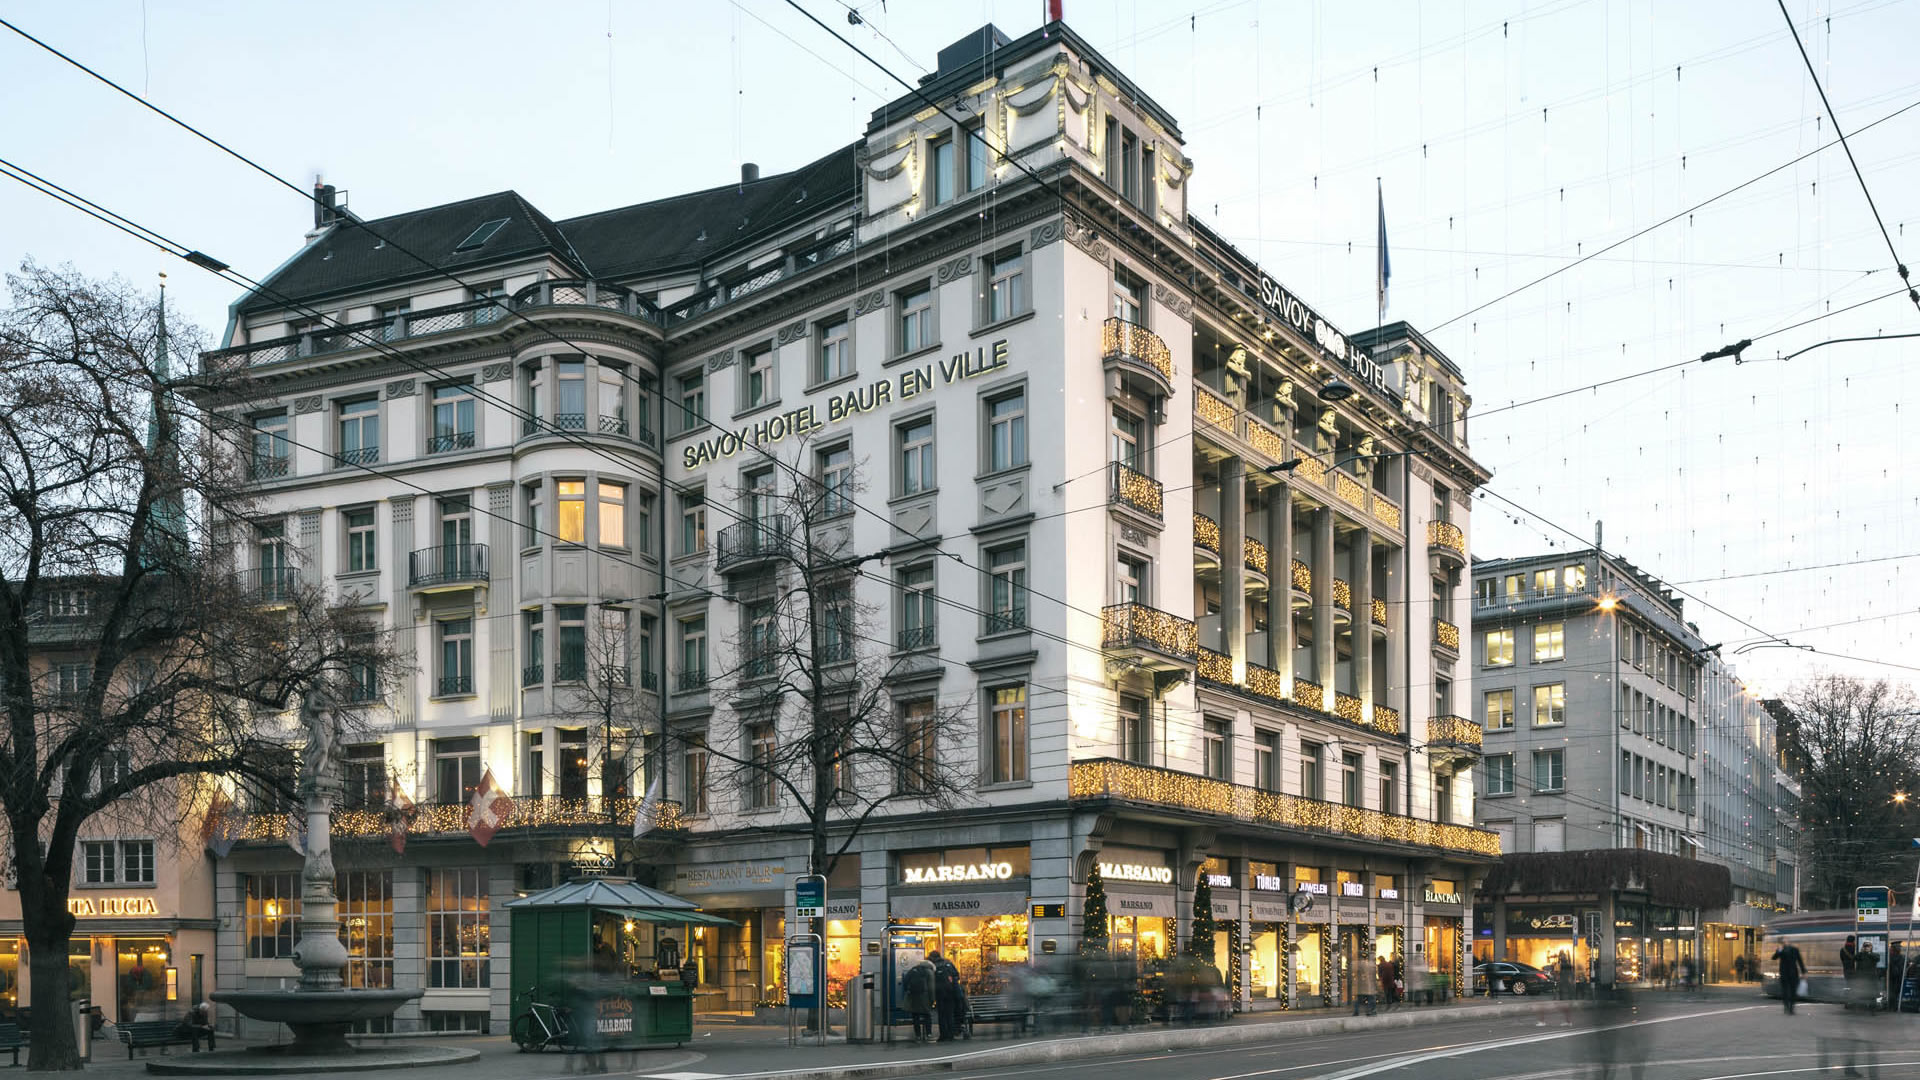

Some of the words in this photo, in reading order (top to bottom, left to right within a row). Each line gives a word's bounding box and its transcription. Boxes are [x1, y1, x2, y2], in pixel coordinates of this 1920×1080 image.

[1262, 277, 1310, 332] SAVOY
[1351, 345, 1389, 394] HOTEL
[683, 427, 748, 470] SAVOY
[754, 405, 822, 445] HOTEL
[828, 379, 892, 422] BAUR
[900, 365, 934, 399] EN
[939, 339, 1009, 384] VILLE
[688, 867, 743, 881] RESTAURANT
[905, 862, 1012, 883] MARSANO
[1100, 863, 1172, 883] MARSANO
[1256, 873, 1280, 891] TÜRLER
[1299, 882, 1328, 894] JUWELEN
[1343, 881, 1363, 896] TÜRLER
[1425, 890, 1461, 903] BLANCPAIN
[100, 898, 158, 915] LUCIA
[827, 905, 856, 914] RSANO
[932, 900, 980, 911] MARSANO
[1120, 900, 1152, 910] MARSANO
